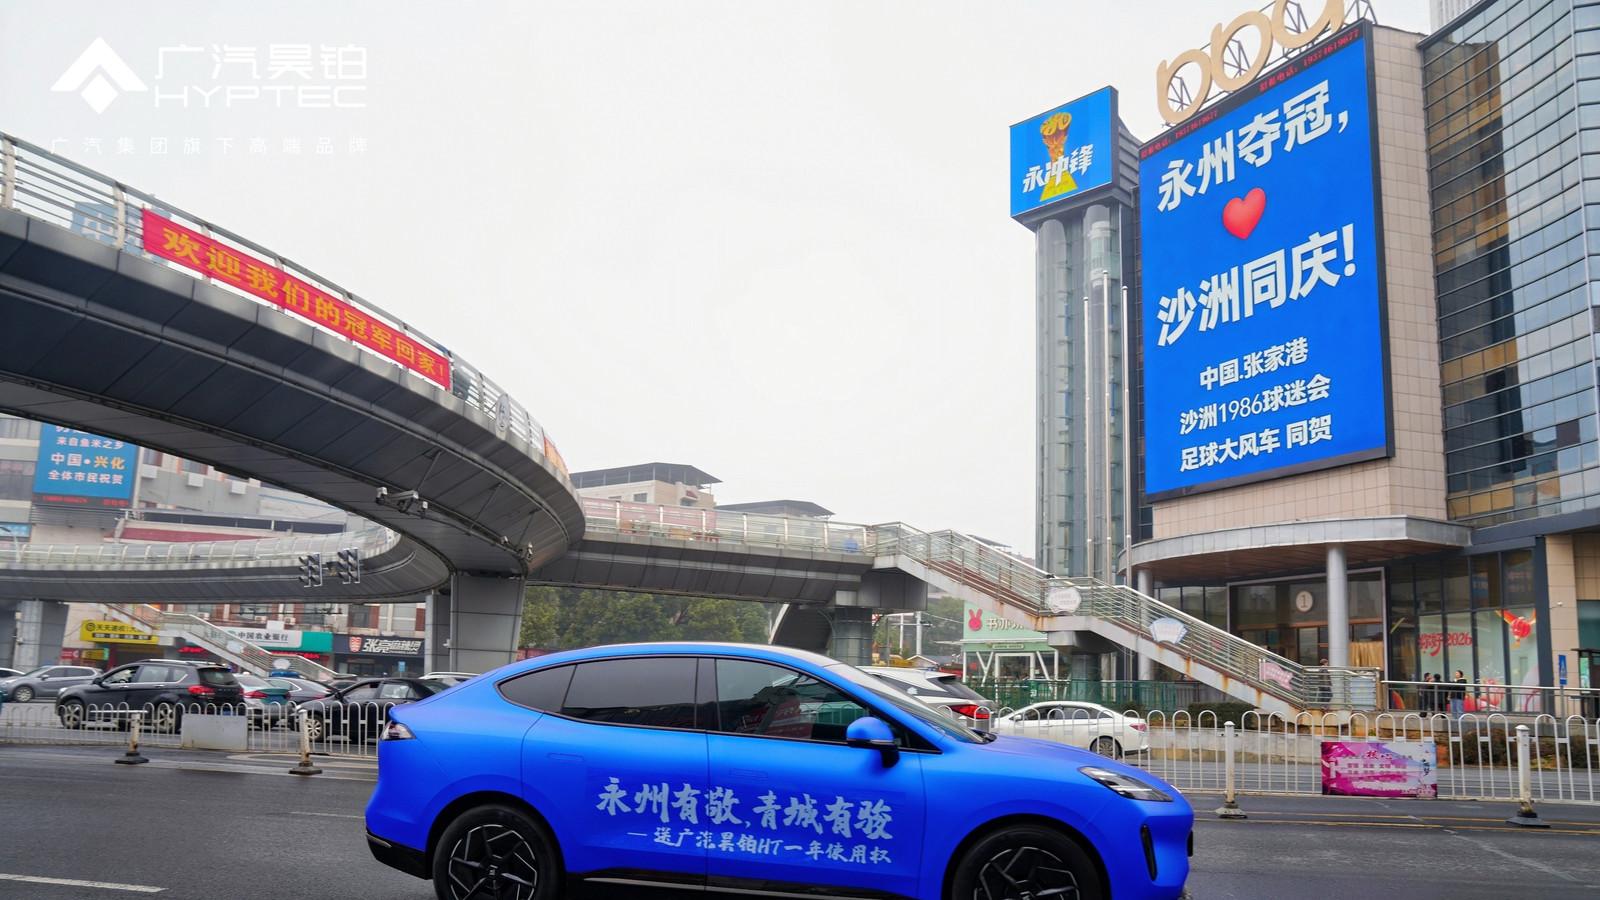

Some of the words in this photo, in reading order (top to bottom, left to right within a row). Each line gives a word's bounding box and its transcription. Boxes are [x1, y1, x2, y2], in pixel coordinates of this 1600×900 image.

[1022, 143, 1094, 193] 永冲锋
[1157, 79, 1348, 212] 永州夺冠，
[1157, 223, 1356, 347] 沙洲同庆！
[1179, 373, 1331, 435] 沙洲1986球迷会
[1180, 428, 1281, 472] 足球大风车
[1286, 414, 1333, 449] 同贺
[48, 469, 124, 485] 全体市民祝贺
[238, 631, 289, 642] 中国农业银行
